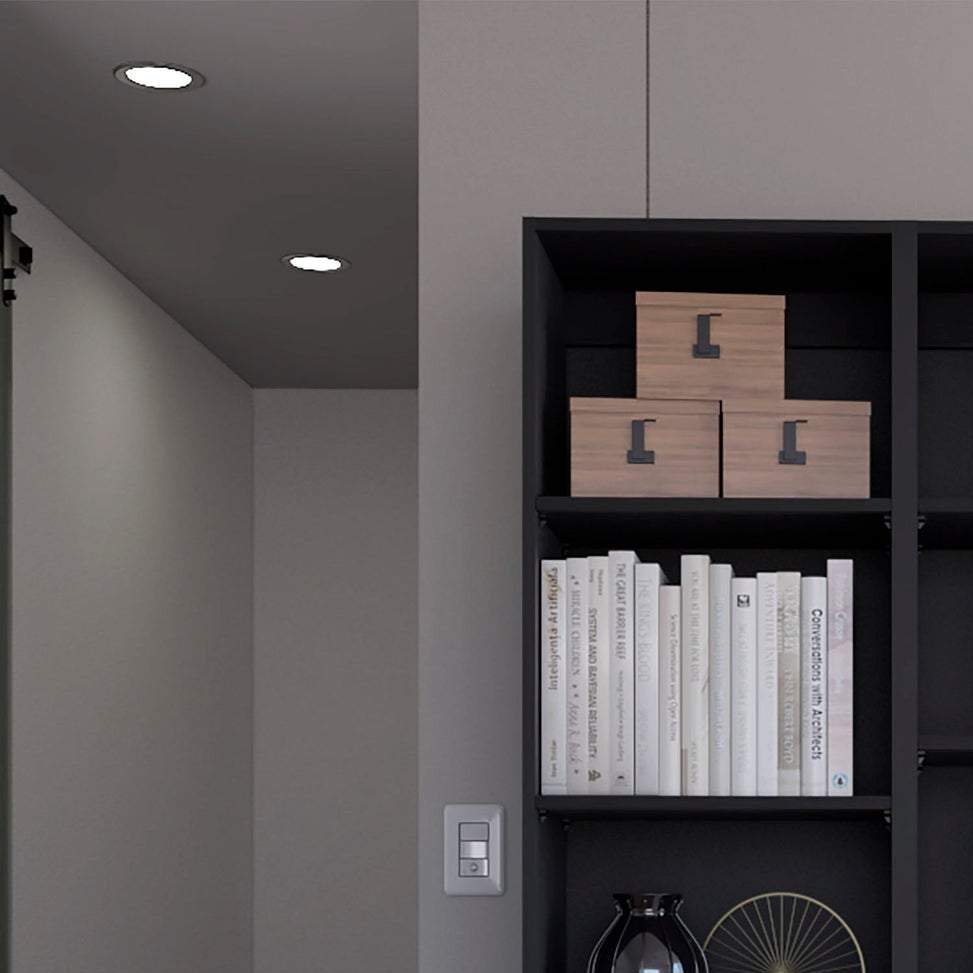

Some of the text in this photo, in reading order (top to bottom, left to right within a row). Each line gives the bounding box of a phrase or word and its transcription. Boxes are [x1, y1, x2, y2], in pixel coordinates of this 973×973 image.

[615, 564, 626, 577] THE
[615, 580, 626, 605] GREAT
[638, 578, 652, 600] THE
[572, 590, 581, 676] MIRACLE CHILDREN
[615, 607, 626, 639] BARRIER
[668, 614, 678, 638] Science
[615, 642, 626, 660] REEF
[638, 642, 652, 682] BLOOD
[588, 608, 598, 759] SYSTEM AND BAYESIAN RELIABILITY
[668, 685, 678, 701] using
[810, 609, 823, 761] Conversations with Architects
[668, 703, 678, 718] Open
[668, 720, 678, 741] Access
